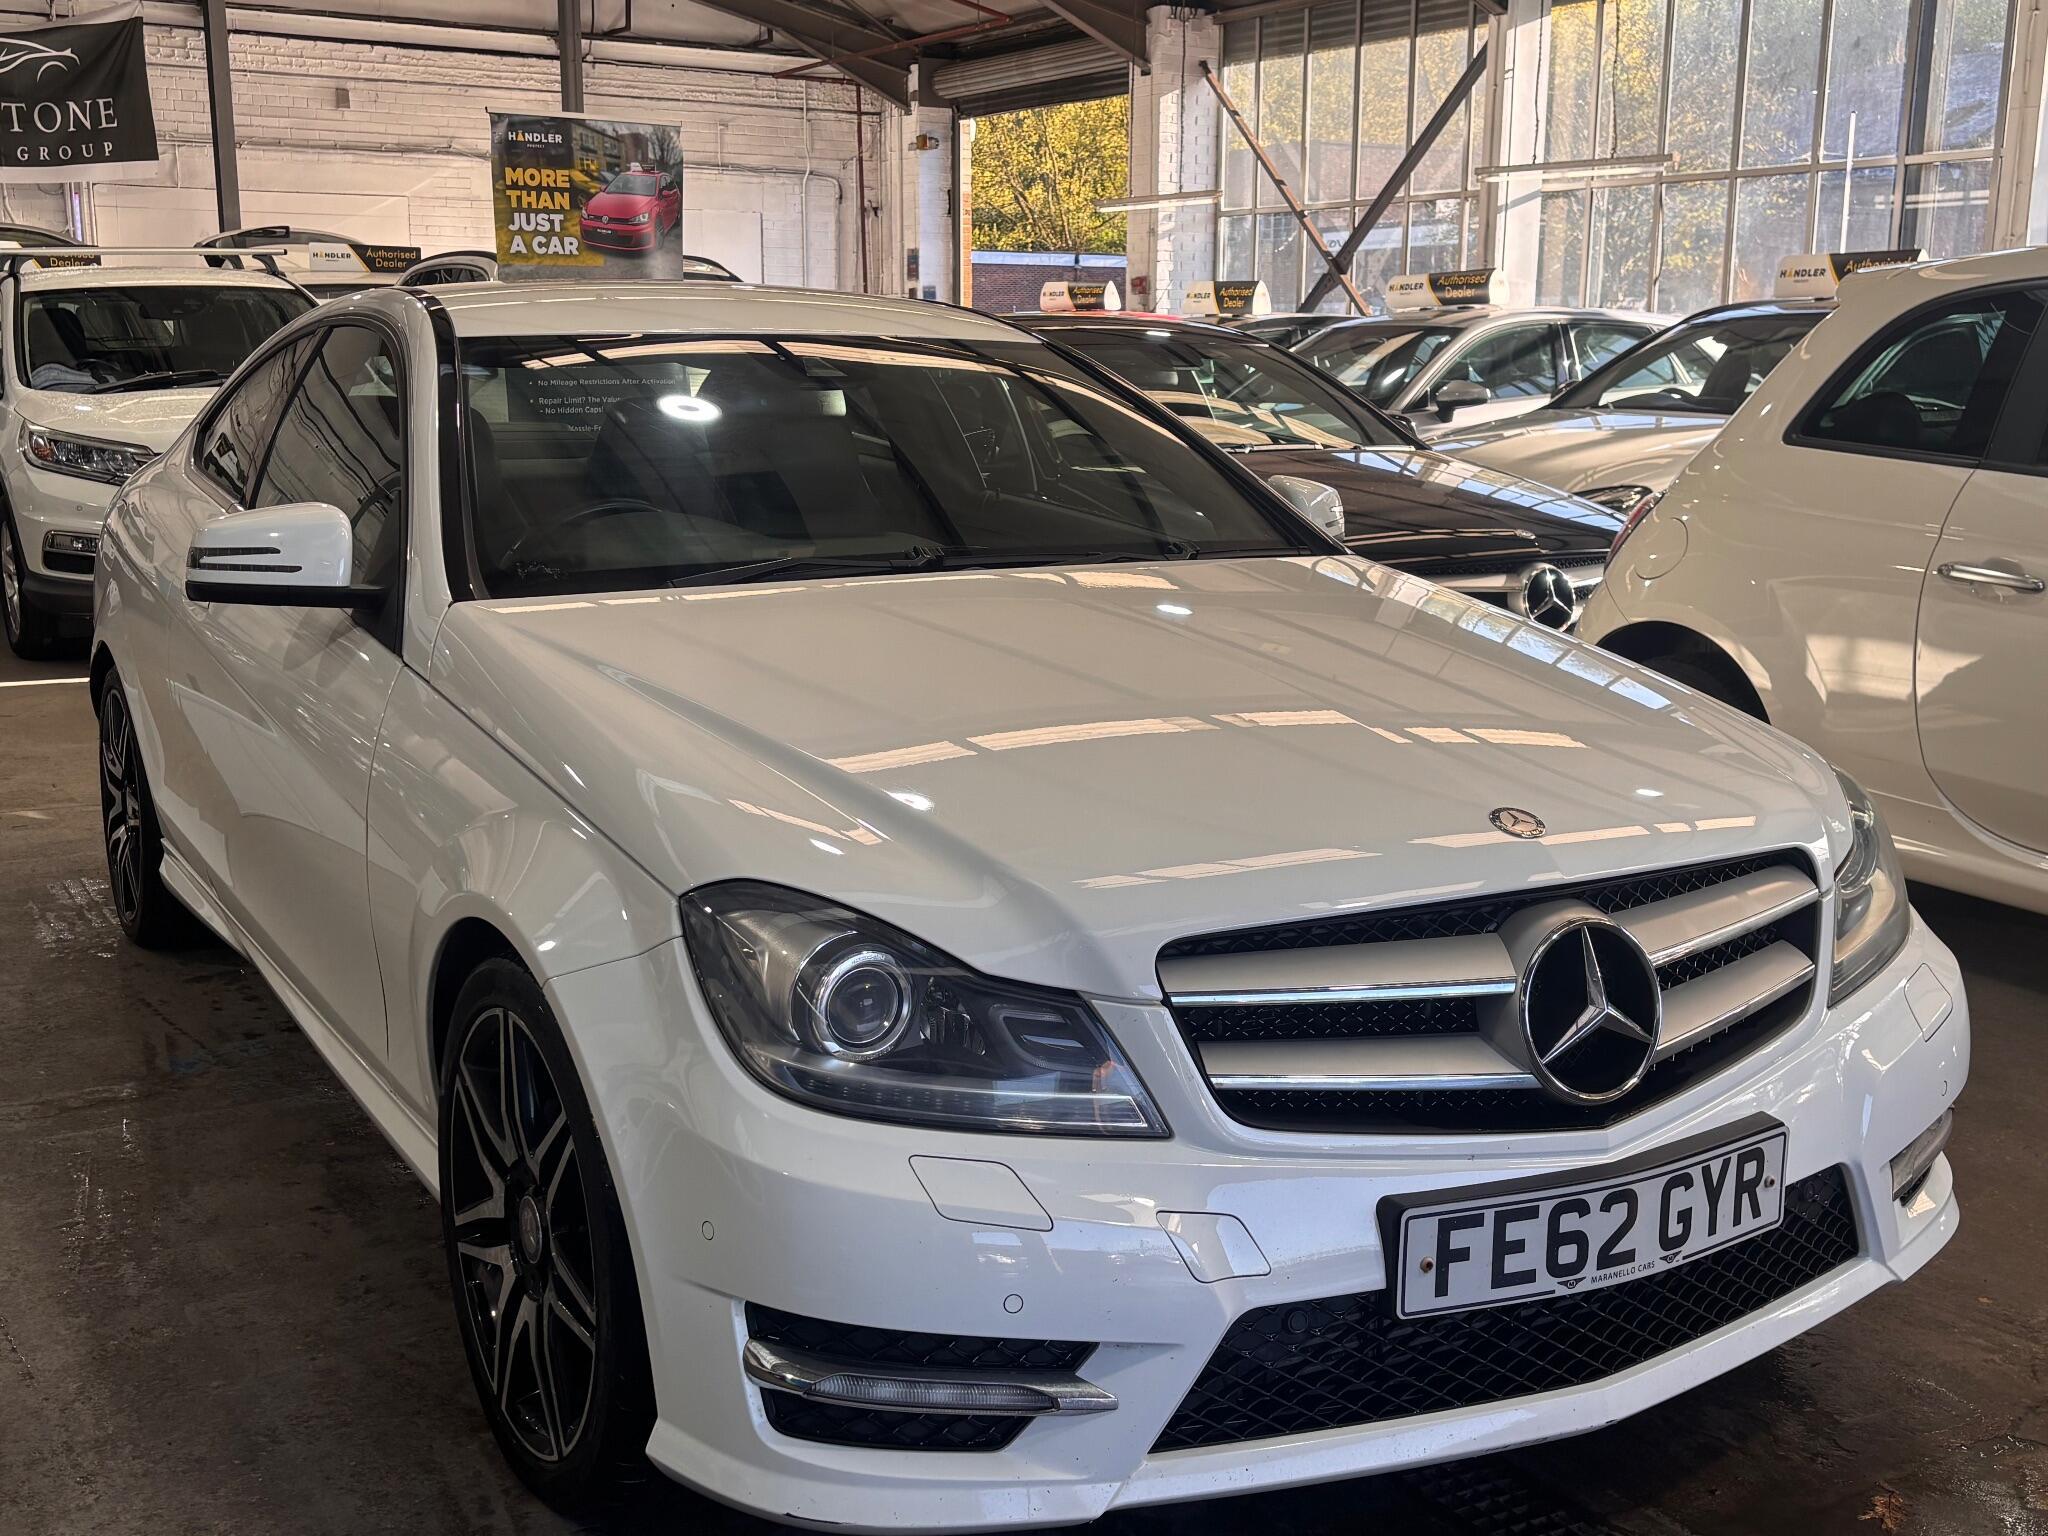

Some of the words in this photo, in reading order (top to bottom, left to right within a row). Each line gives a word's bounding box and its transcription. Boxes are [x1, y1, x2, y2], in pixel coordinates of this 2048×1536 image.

[17, 141, 113, 161] GROUP
[505, 167, 571, 188] MORE
[505, 189, 571, 210] THAN
[508, 212, 564, 232] JUST
[509, 235, 528, 254] A
[532, 235, 579, 255] CAR
[366, 248, 416, 259] Authorised
[50, 257, 85, 267] Dealer
[375, 258, 407, 268] Dealer
[1436, 273, 1488, 285] Authorised
[1072, 286, 1104, 294] Authorised
[1220, 286, 1255, 296] Authorised
[1445, 286, 1475, 298] Dealer
[1077, 294, 1097, 303] Dealer
[1223, 297, 1244, 308] Dealer
[539, 397, 561, 405] Repair
[557, 406, 583, 414] Hidden
[585, 406, 604, 414] Caps!
[1434, 1187, 1639, 1298] FE62
[1658, 1146, 1765, 1252] GYR
[1590, 1266, 1636, 1284] MARANELLO
[1637, 1261, 1655, 1272] CARS
